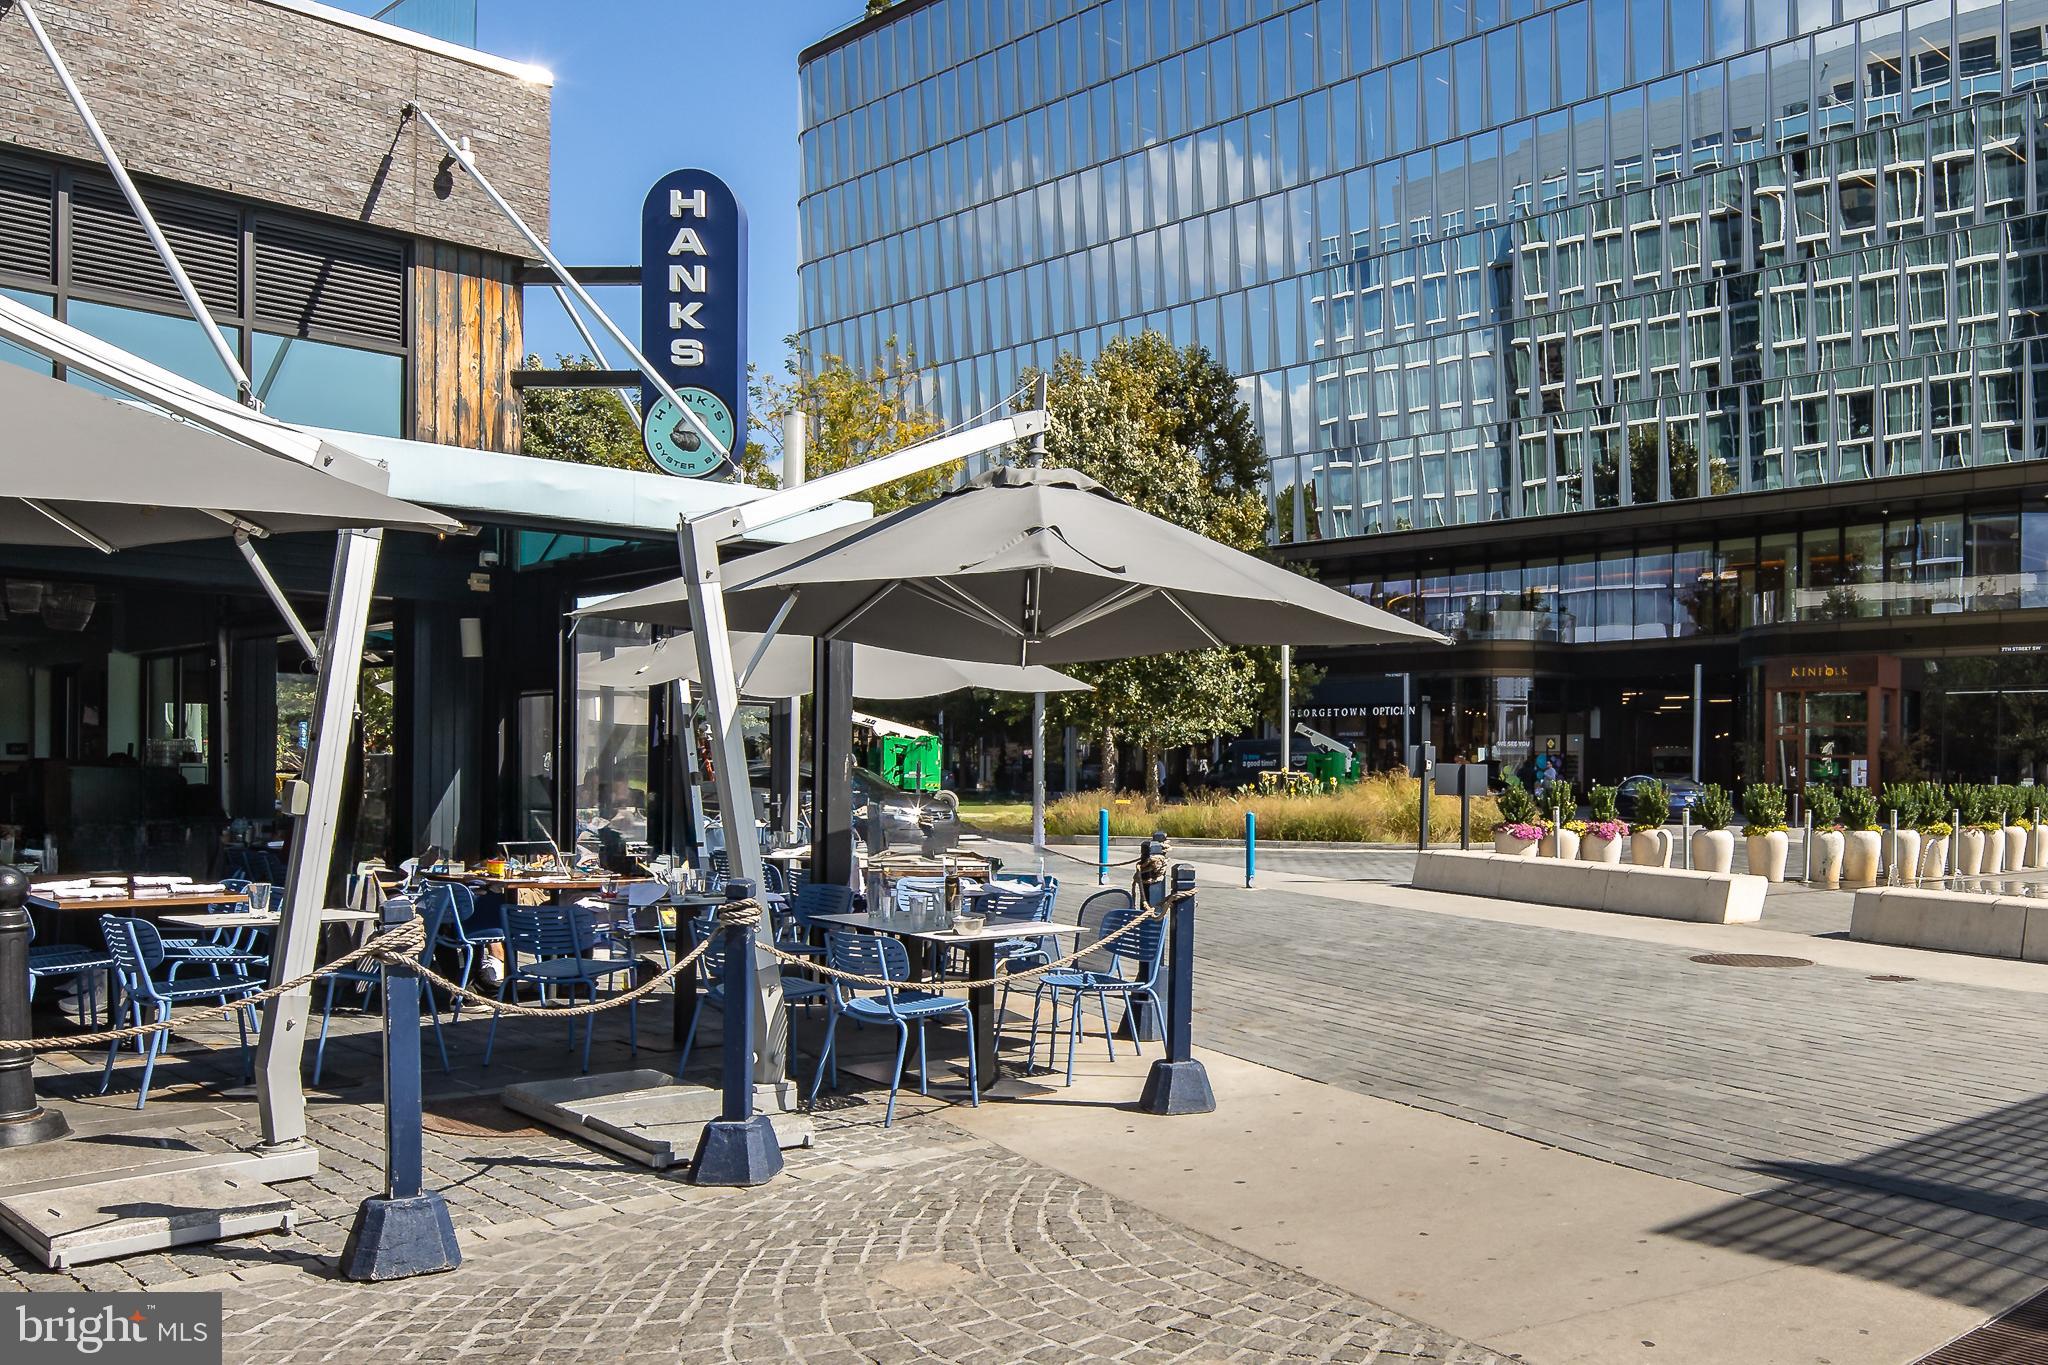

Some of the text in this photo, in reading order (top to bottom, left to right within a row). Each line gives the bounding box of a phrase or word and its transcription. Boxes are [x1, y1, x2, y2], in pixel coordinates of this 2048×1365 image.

[667, 189, 707, 367] HANKS
[655, 442, 696, 469] OYSTER
[1372, 706, 1416, 716] OPTICIN
[1247, 760, 1260, 768] good
